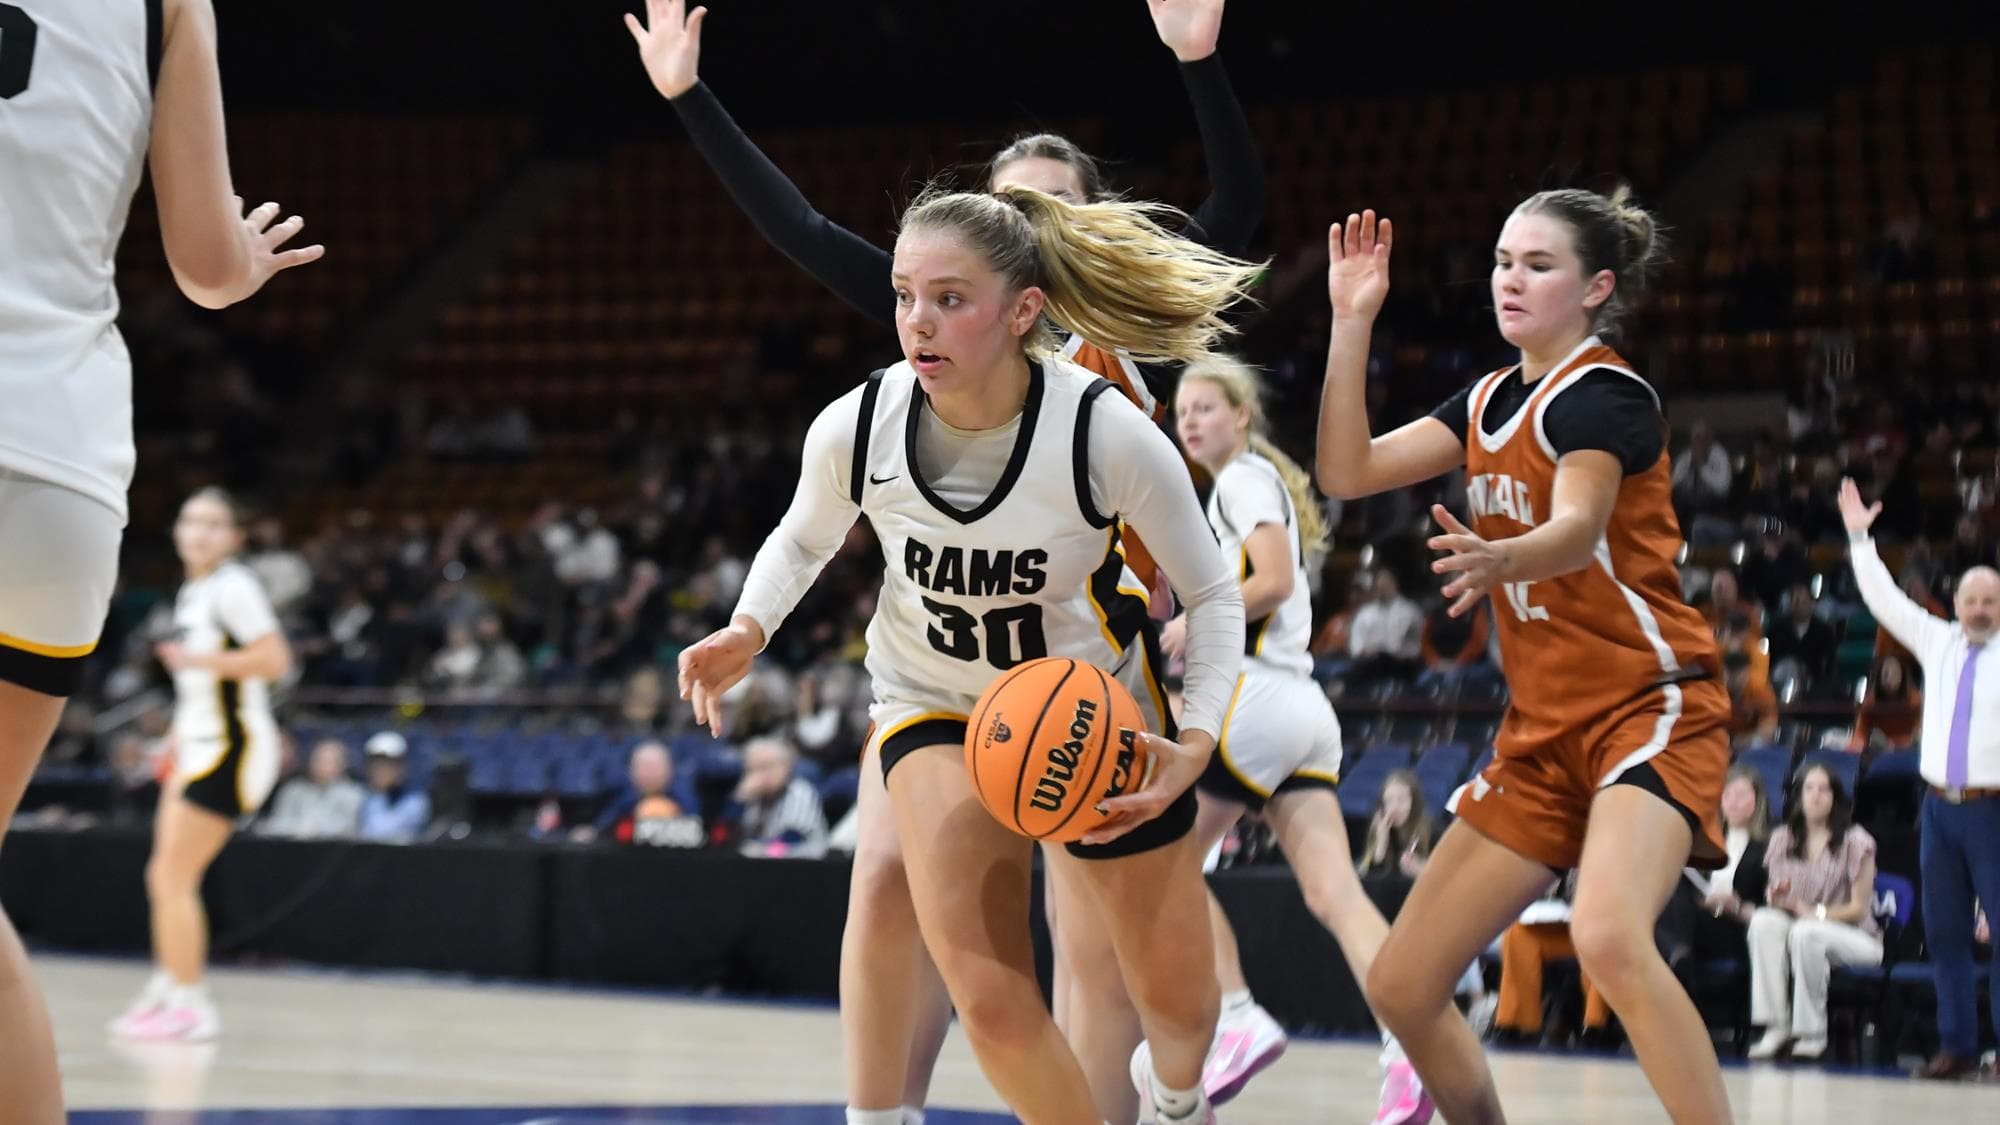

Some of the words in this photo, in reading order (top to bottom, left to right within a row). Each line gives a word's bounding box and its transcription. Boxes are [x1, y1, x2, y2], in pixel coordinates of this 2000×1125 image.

[904, 536, 1048, 596] RAMS
[922, 595, 1048, 671] 30
[1030, 699, 1097, 813] Wilson
